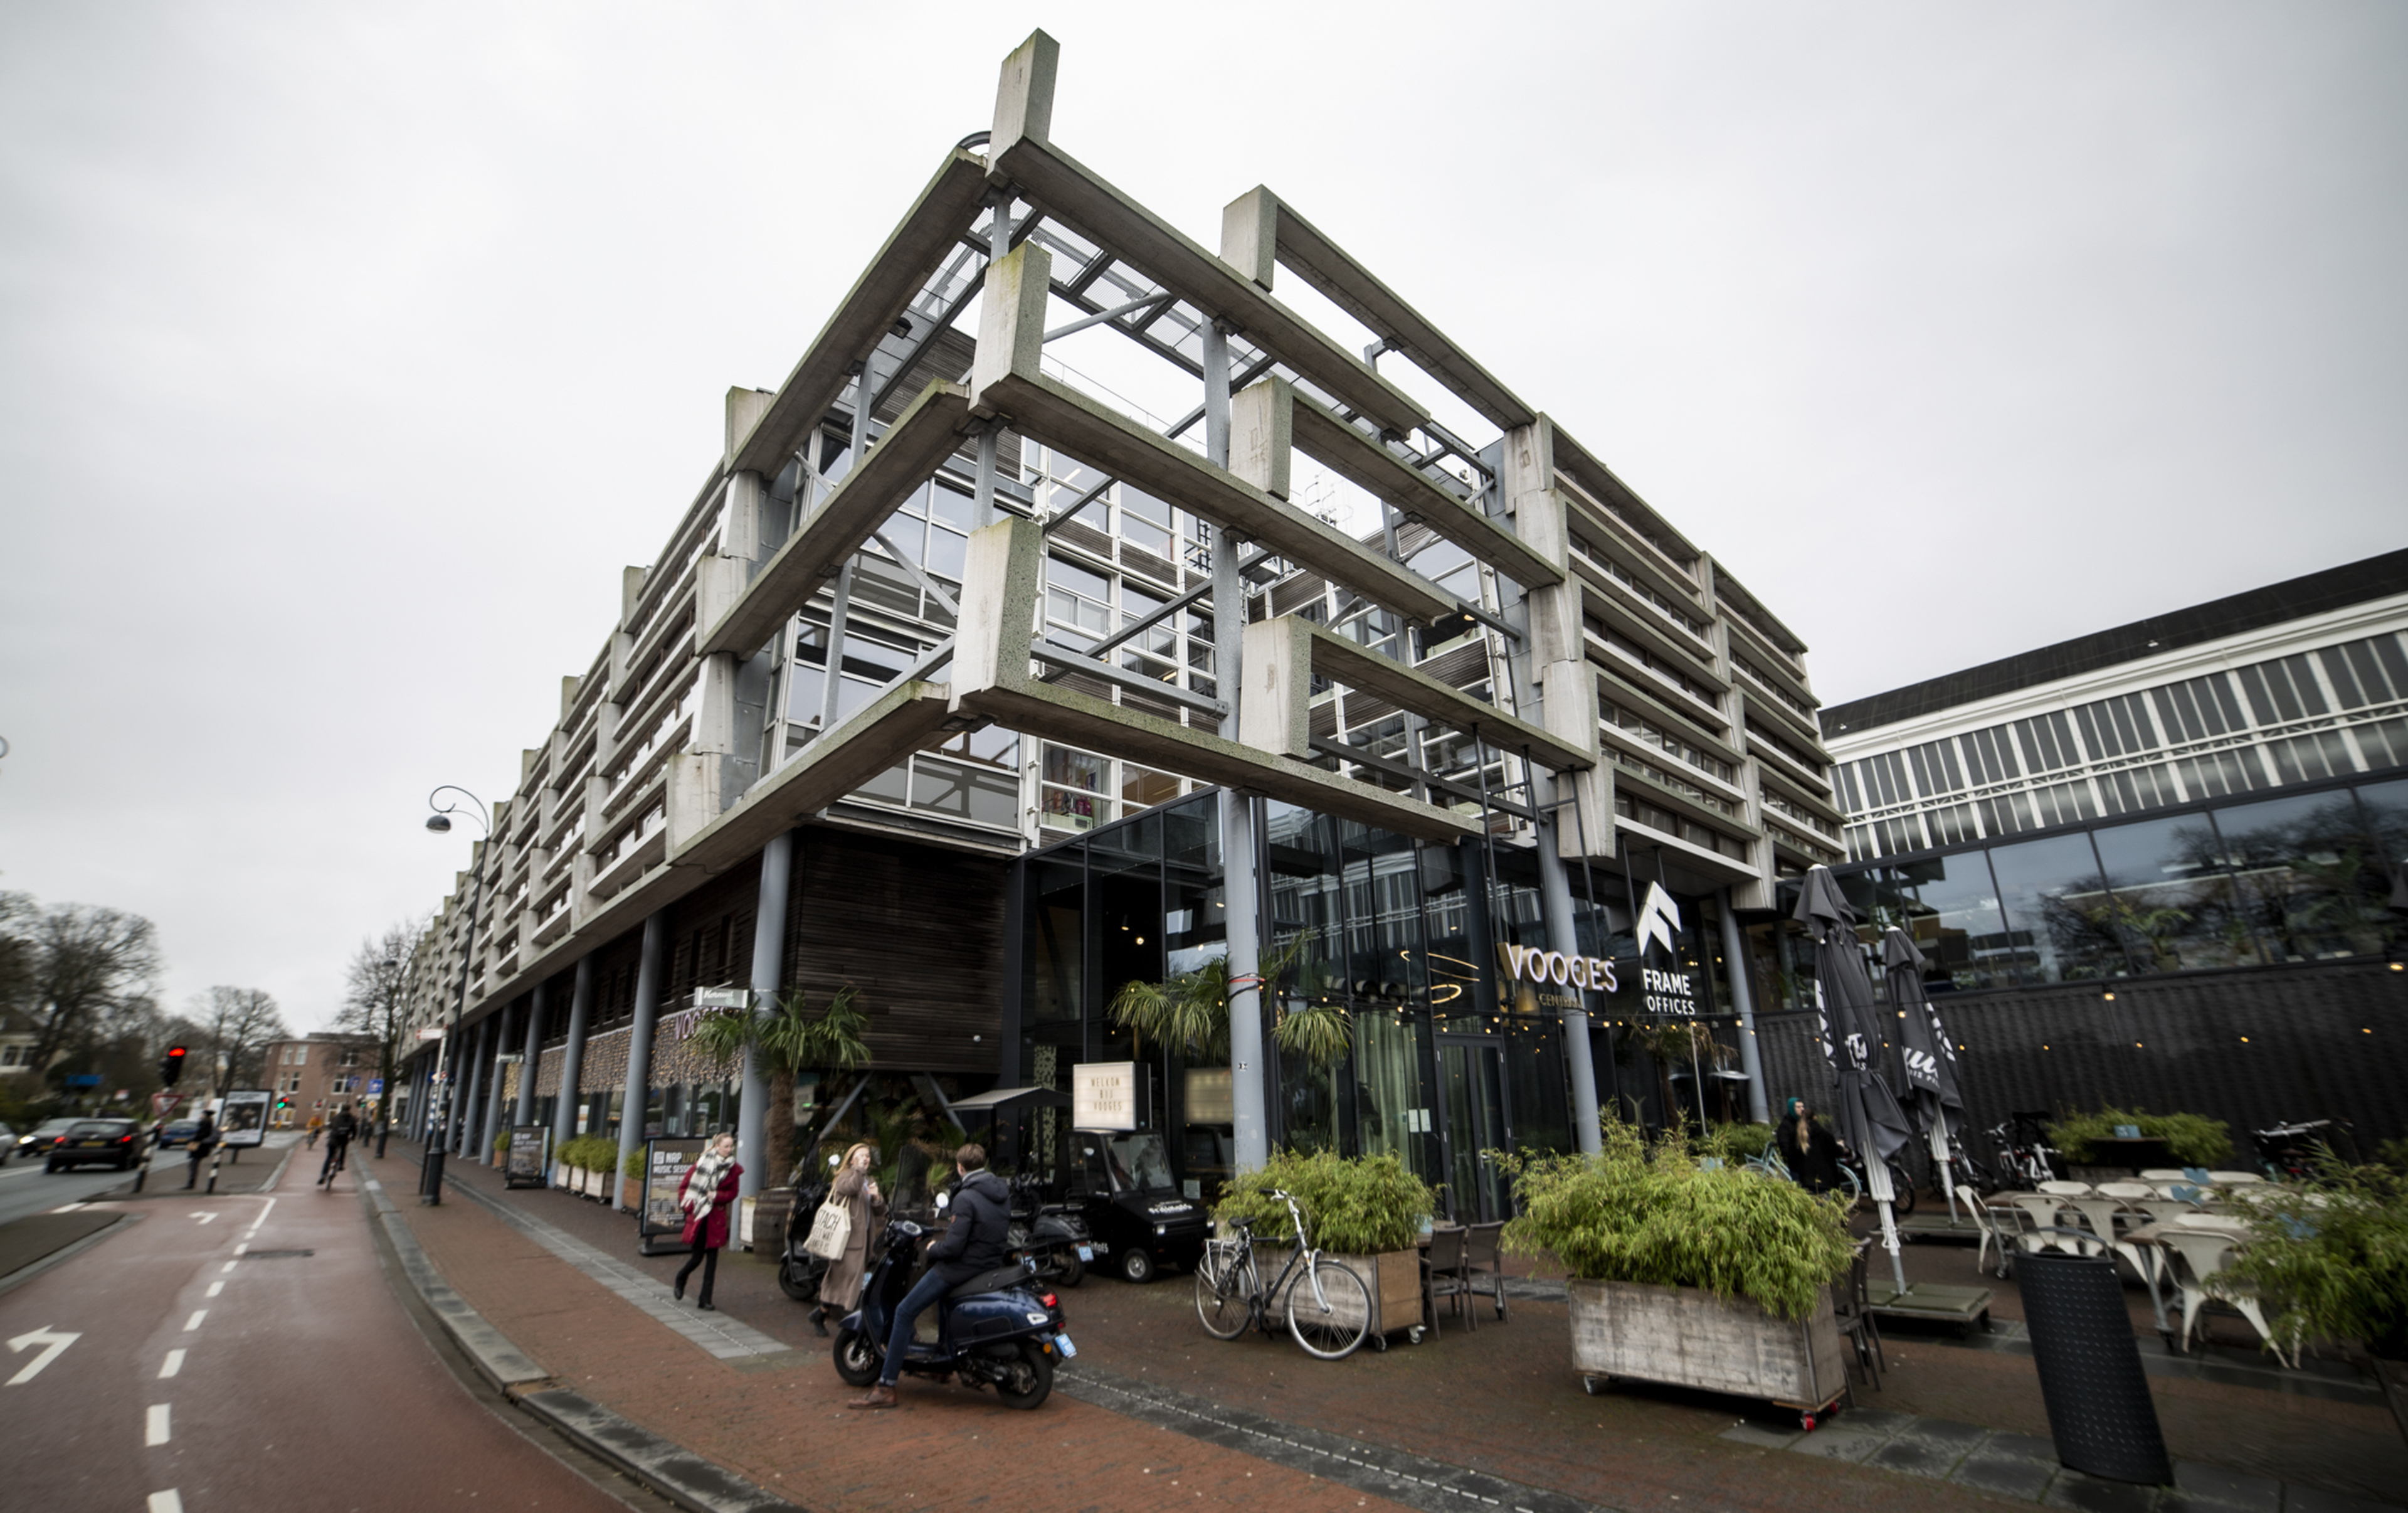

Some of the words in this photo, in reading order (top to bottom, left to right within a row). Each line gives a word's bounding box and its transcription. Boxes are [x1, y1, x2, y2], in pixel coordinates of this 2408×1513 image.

[1498, 942, 1618, 993] VOOGES
[1642, 969, 1692, 996] FRAME
[1646, 995, 1696, 1016] OFFICES
[1091, 1077, 1120, 1087] WELKOM
[1100, 1089, 1113, 1099] BIJ
[1094, 1101, 1122, 1111] VOOGES
[665, 1152, 682, 1164] NAP
[653, 1164, 672, 1174] MUSIC
[815, 1209, 842, 1231] STACH
